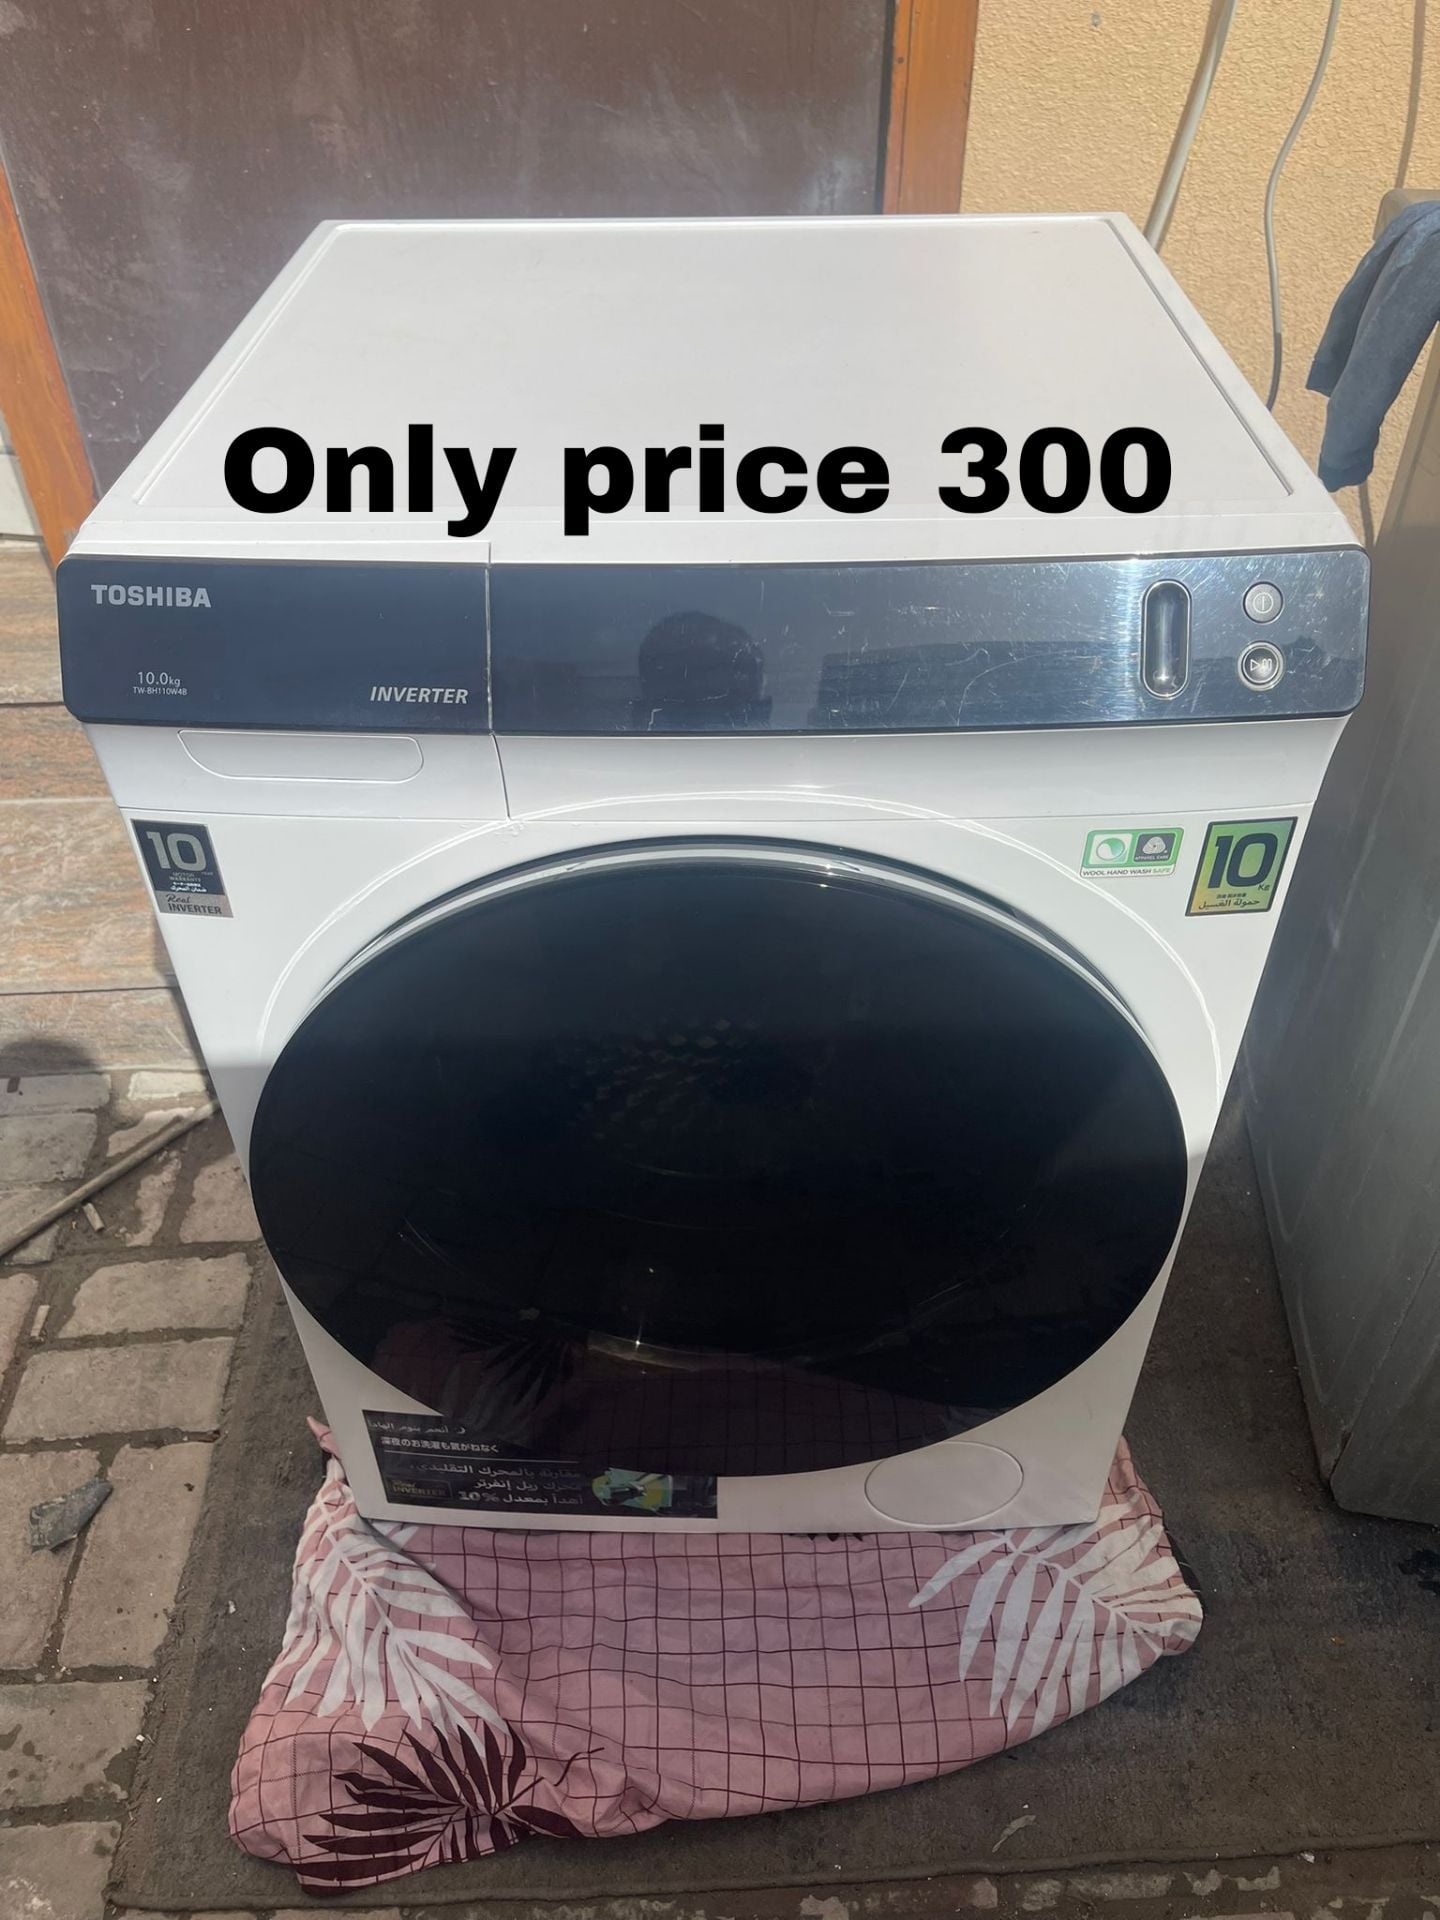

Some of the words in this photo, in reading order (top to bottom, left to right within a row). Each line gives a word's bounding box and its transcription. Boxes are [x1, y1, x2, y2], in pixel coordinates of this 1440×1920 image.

[91, 584, 211, 608] TOSHIBA
[137, 671, 181, 688] 10.0kg
[370, 686, 468, 704] INVERTER
[146, 831, 207, 872] 10
[1207, 832, 1278, 889] 10
[168, 903, 222, 914] INVERTER
